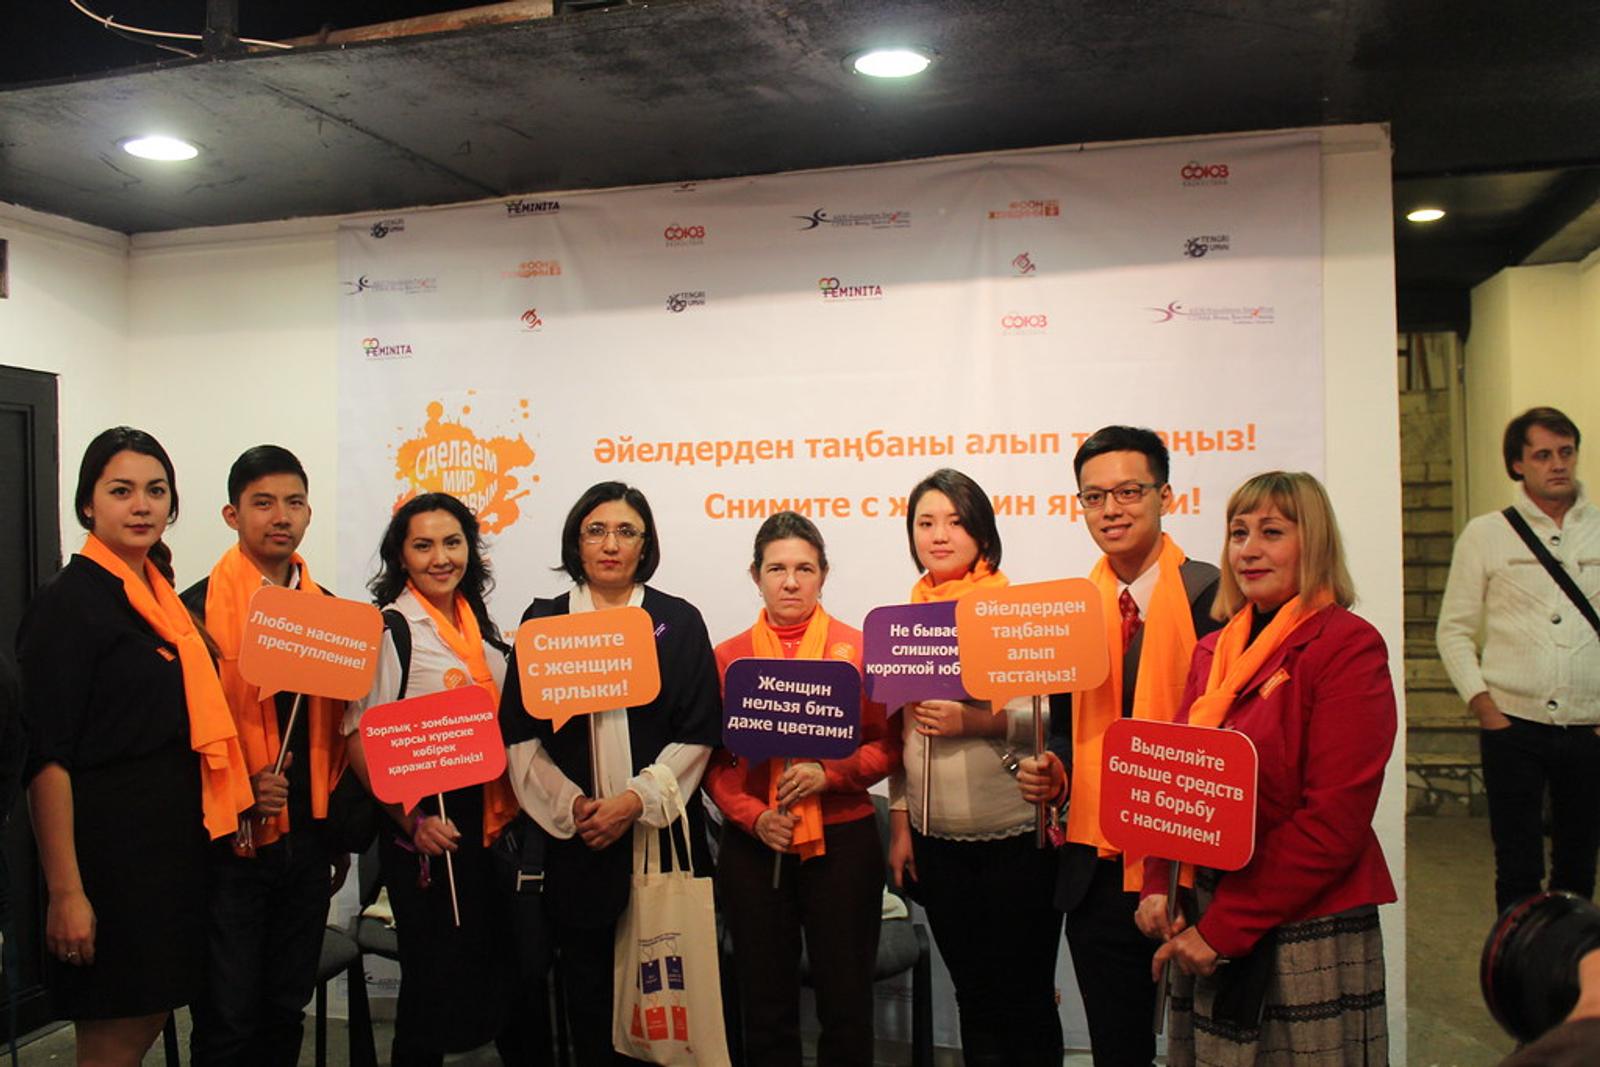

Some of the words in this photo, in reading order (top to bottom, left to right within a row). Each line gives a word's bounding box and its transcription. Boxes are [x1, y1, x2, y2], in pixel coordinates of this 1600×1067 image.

[823, 284, 882, 298] FEMINITA
[366, 344, 413, 357] FEMINITA
[594, 436, 794, 467] Әйелдерден
[805, 430, 954, 462] таңбаны
[966, 432, 1060, 455] алып
[704, 493, 851, 519] Снимите
[861, 496, 879, 517] с
[975, 600, 1086, 617] Әйелдерден
[250, 610, 303, 636] Любое
[306, 627, 368, 652] насилие
[890, 624, 910, 637] Не
[913, 623, 958, 637] бывае
[991, 622, 1070, 640] таңбаны
[533, 632, 625, 651] Снимите
[891, 645, 959, 656] слишком
[257, 634, 367, 671] преступление!
[1007, 647, 1056, 660] алып
[527, 663, 539, 677] с
[544, 656, 633, 675] женщин
[866, 661, 934, 678] короткой
[938, 661, 960, 676] юб
[987, 667, 1077, 685] тастаңыз!
[541, 679, 629, 705] ярлыки!
[757, 675, 832, 697] Женщин
[742, 697, 800, 714] нельзя
[805, 701, 844, 718] бить
[366, 722, 412, 737] Зорлық
[727, 716, 773, 731] даже
[777, 721, 854, 739] цветами!
[390, 736, 426, 748] қарсы
[1130, 736, 1225, 771] Выделяйте
[388, 759, 437, 776] қаражат
[1109, 755, 1172, 784] больше
[1176, 774, 1244, 801] средств
[1131, 788, 1150, 804] на
[1155, 791, 1215, 823] борьбу
[1120, 809, 1129, 823] с
[1133, 812, 1222, 847] насилием!
